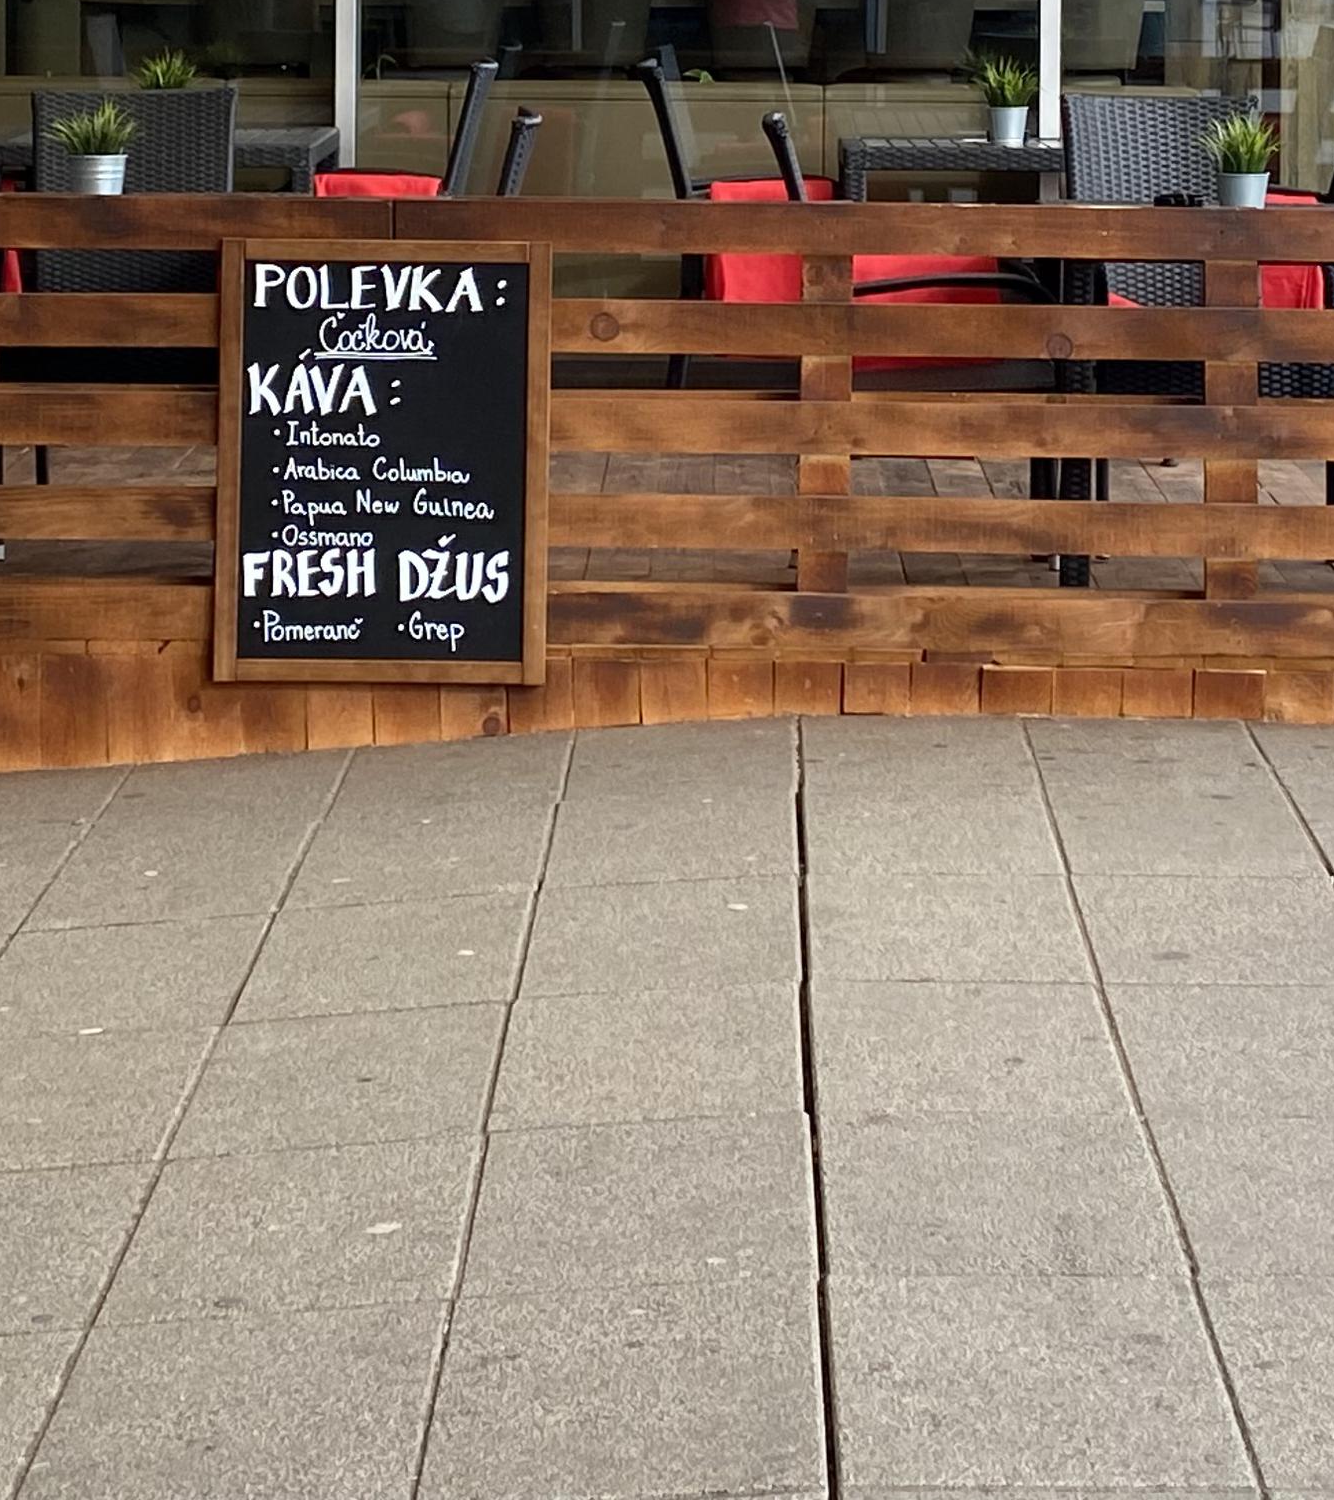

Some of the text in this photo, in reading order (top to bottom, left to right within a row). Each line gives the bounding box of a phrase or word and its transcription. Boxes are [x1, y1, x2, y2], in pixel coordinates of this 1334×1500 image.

[285, 420, 380, 448] Intonato
[283, 457, 471, 485] Arabica Columbia
[281, 487, 494, 526] Papua New Guinea
[281, 526, 374, 548] Ossmano
[243, 534, 510, 604] FRESH DŽUS
[262, 610, 465, 652] Pomeranč Grep
